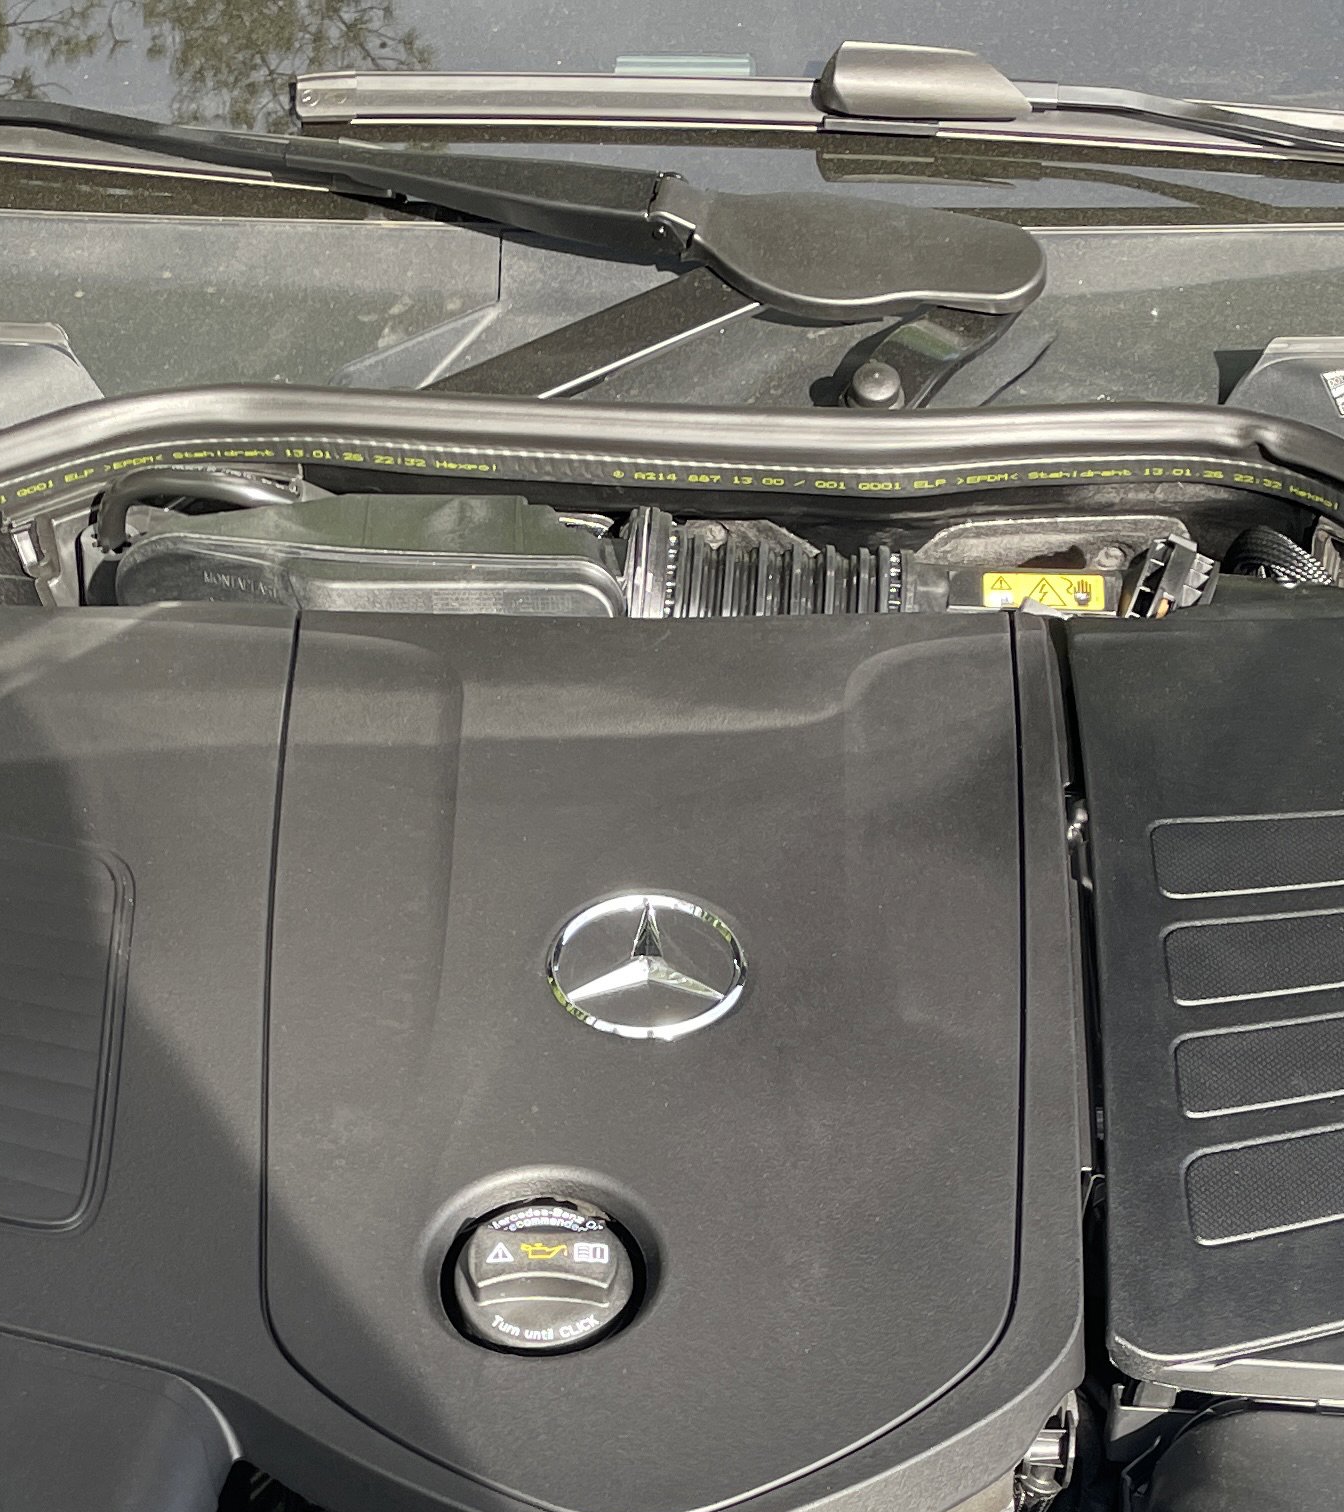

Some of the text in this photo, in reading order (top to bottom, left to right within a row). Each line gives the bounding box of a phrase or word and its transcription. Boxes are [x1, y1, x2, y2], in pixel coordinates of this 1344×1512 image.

[492, 1314, 599, 1340] Turn until CLICK
